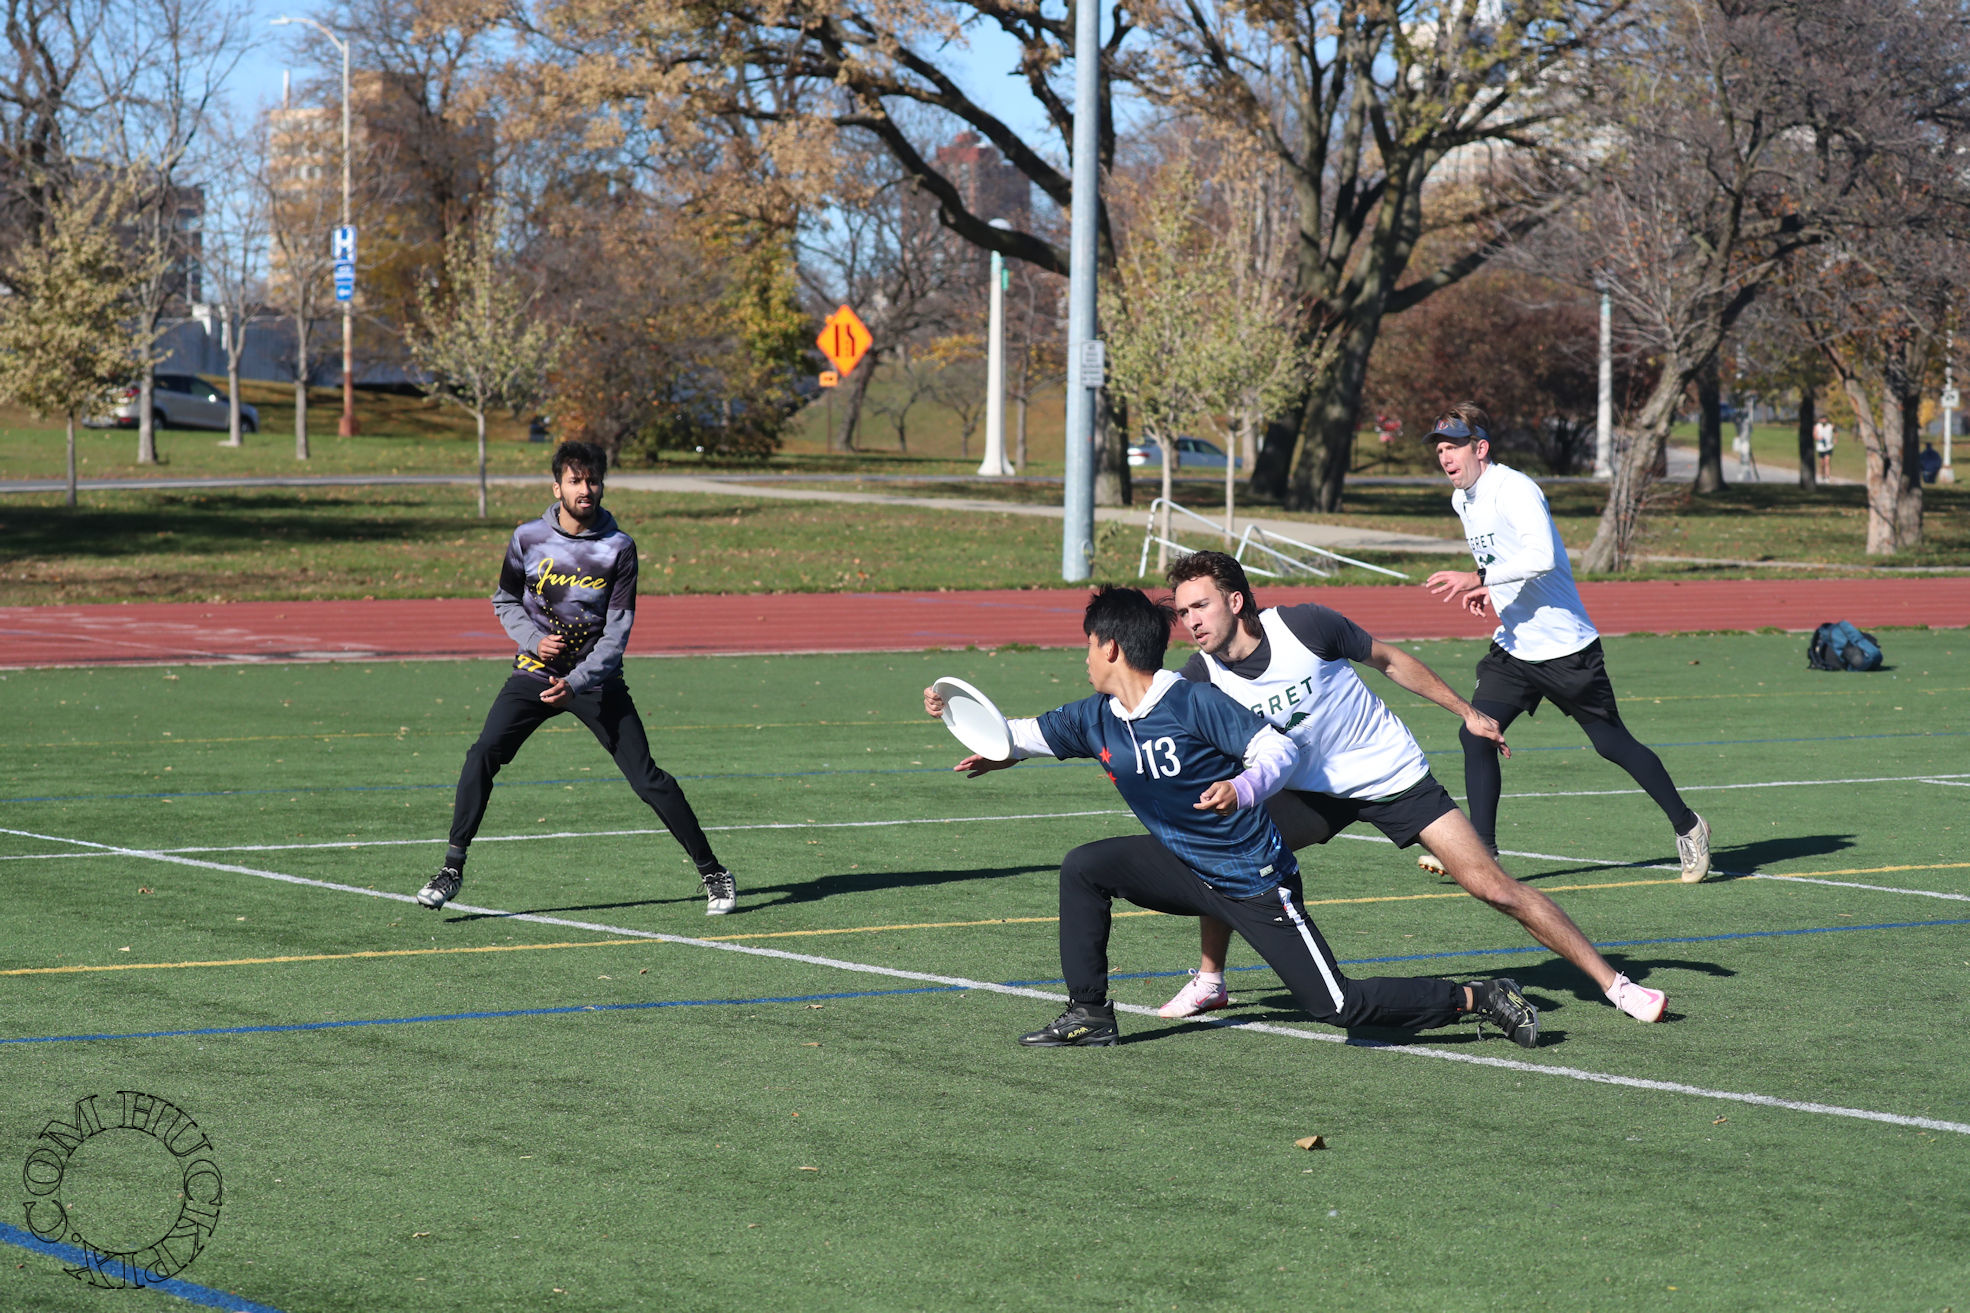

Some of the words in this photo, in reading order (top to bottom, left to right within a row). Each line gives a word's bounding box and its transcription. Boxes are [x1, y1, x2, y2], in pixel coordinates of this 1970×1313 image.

[334, 227, 354, 261] H
[536, 557, 607, 595] Juice
[517, 654, 545, 672] 77
[1141, 736, 1181, 779] 13
